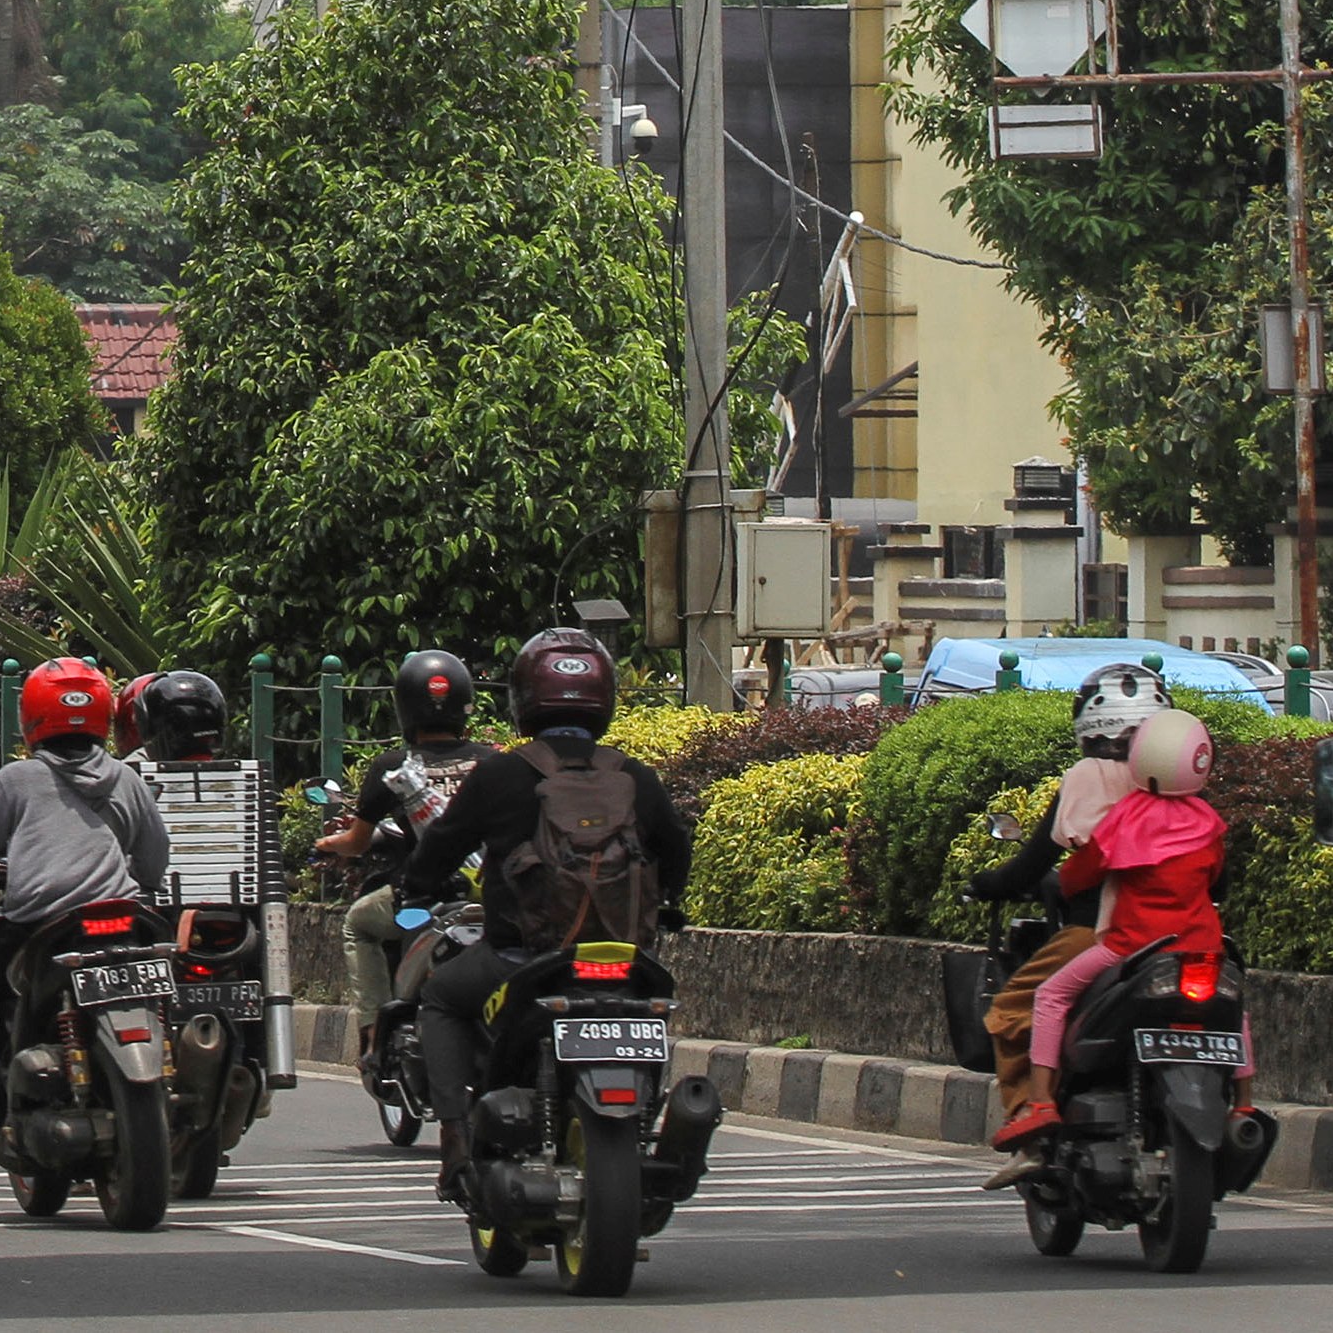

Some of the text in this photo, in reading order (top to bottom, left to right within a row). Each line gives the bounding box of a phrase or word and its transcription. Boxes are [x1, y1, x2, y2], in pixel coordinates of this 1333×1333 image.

[74, 973, 86, 990] F
[187, 987, 221, 1003] 3577
[557, 1023, 663, 1040] F 4098 UBC
[1142, 1033, 1154, 1047] B
[1159, 1033, 1203, 1048] 4343
